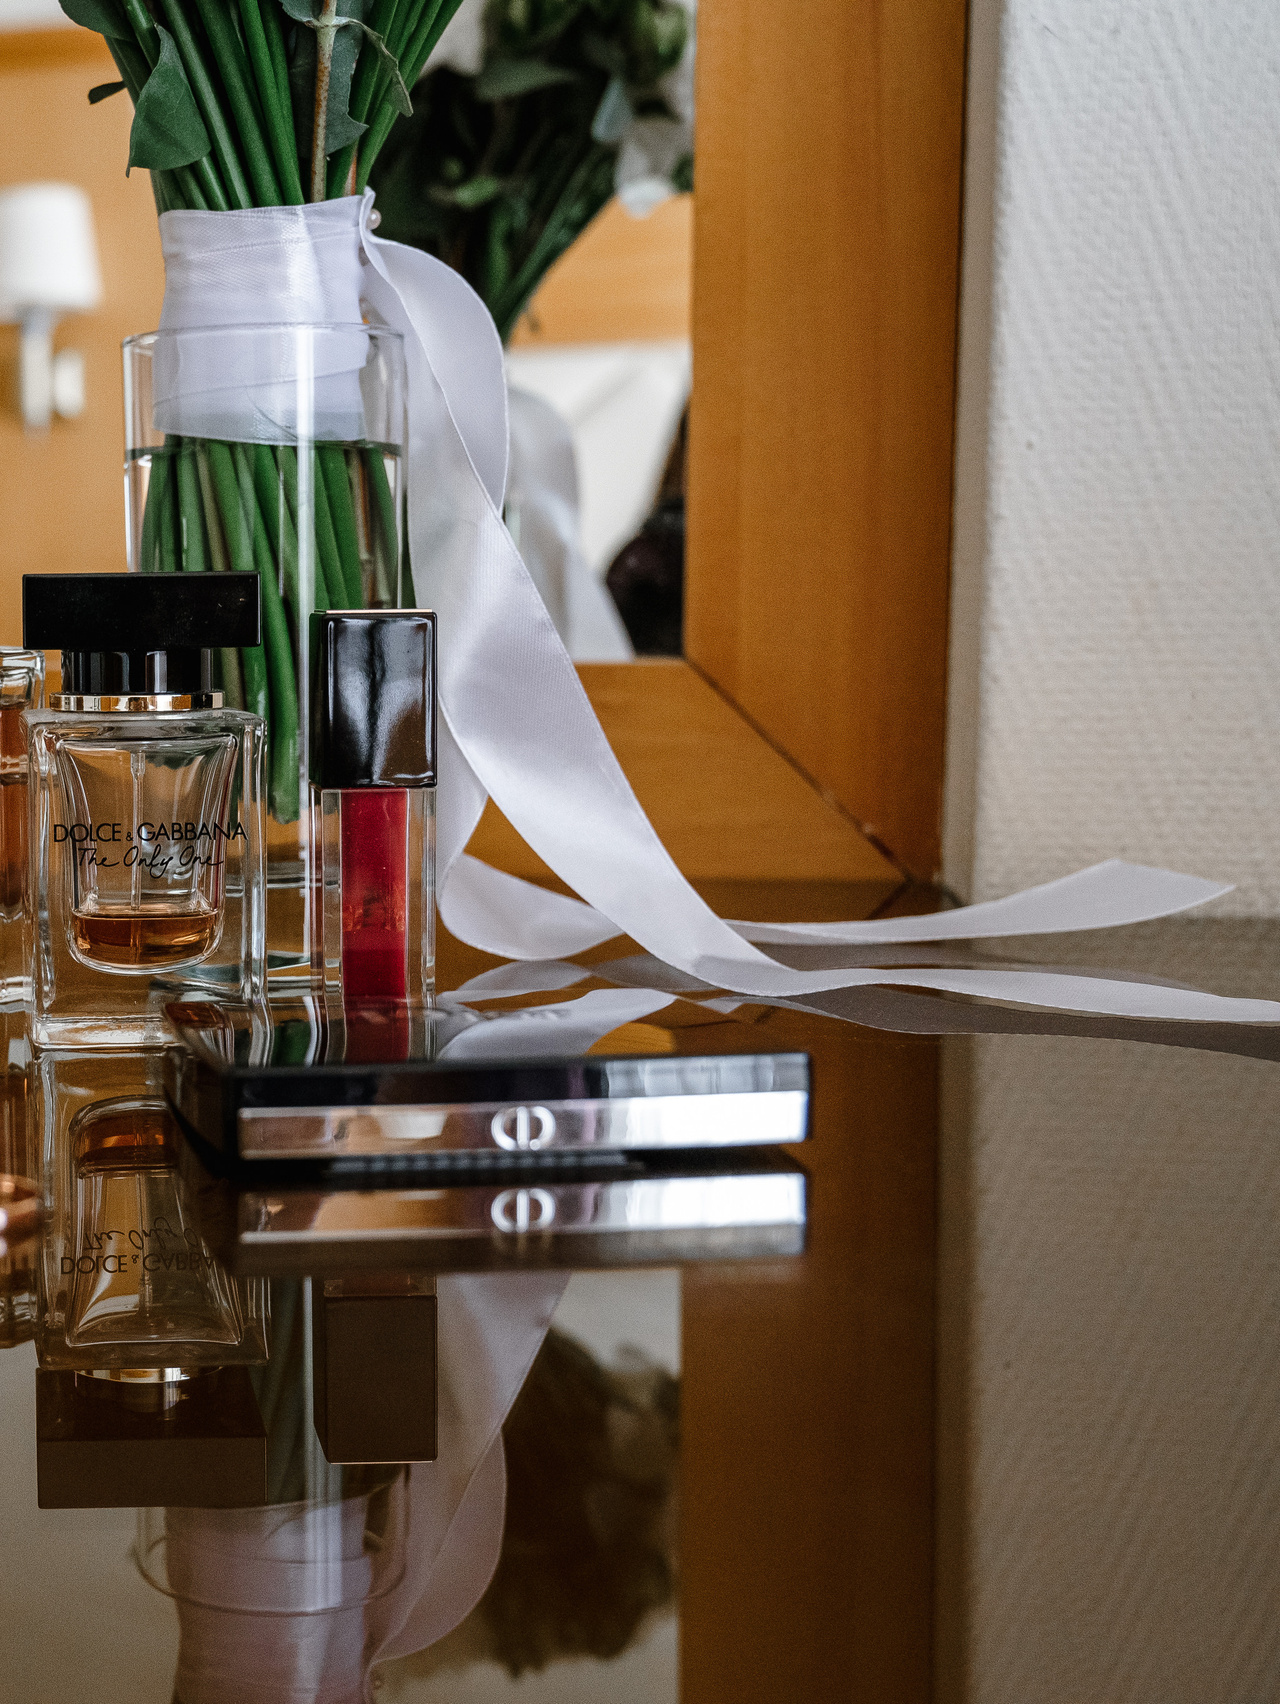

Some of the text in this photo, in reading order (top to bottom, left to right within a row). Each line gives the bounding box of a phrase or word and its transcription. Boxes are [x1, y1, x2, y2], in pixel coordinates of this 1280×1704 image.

[53, 822, 248, 843] DOLCE & GABBANA
[78, 843, 225, 879] The Only One
